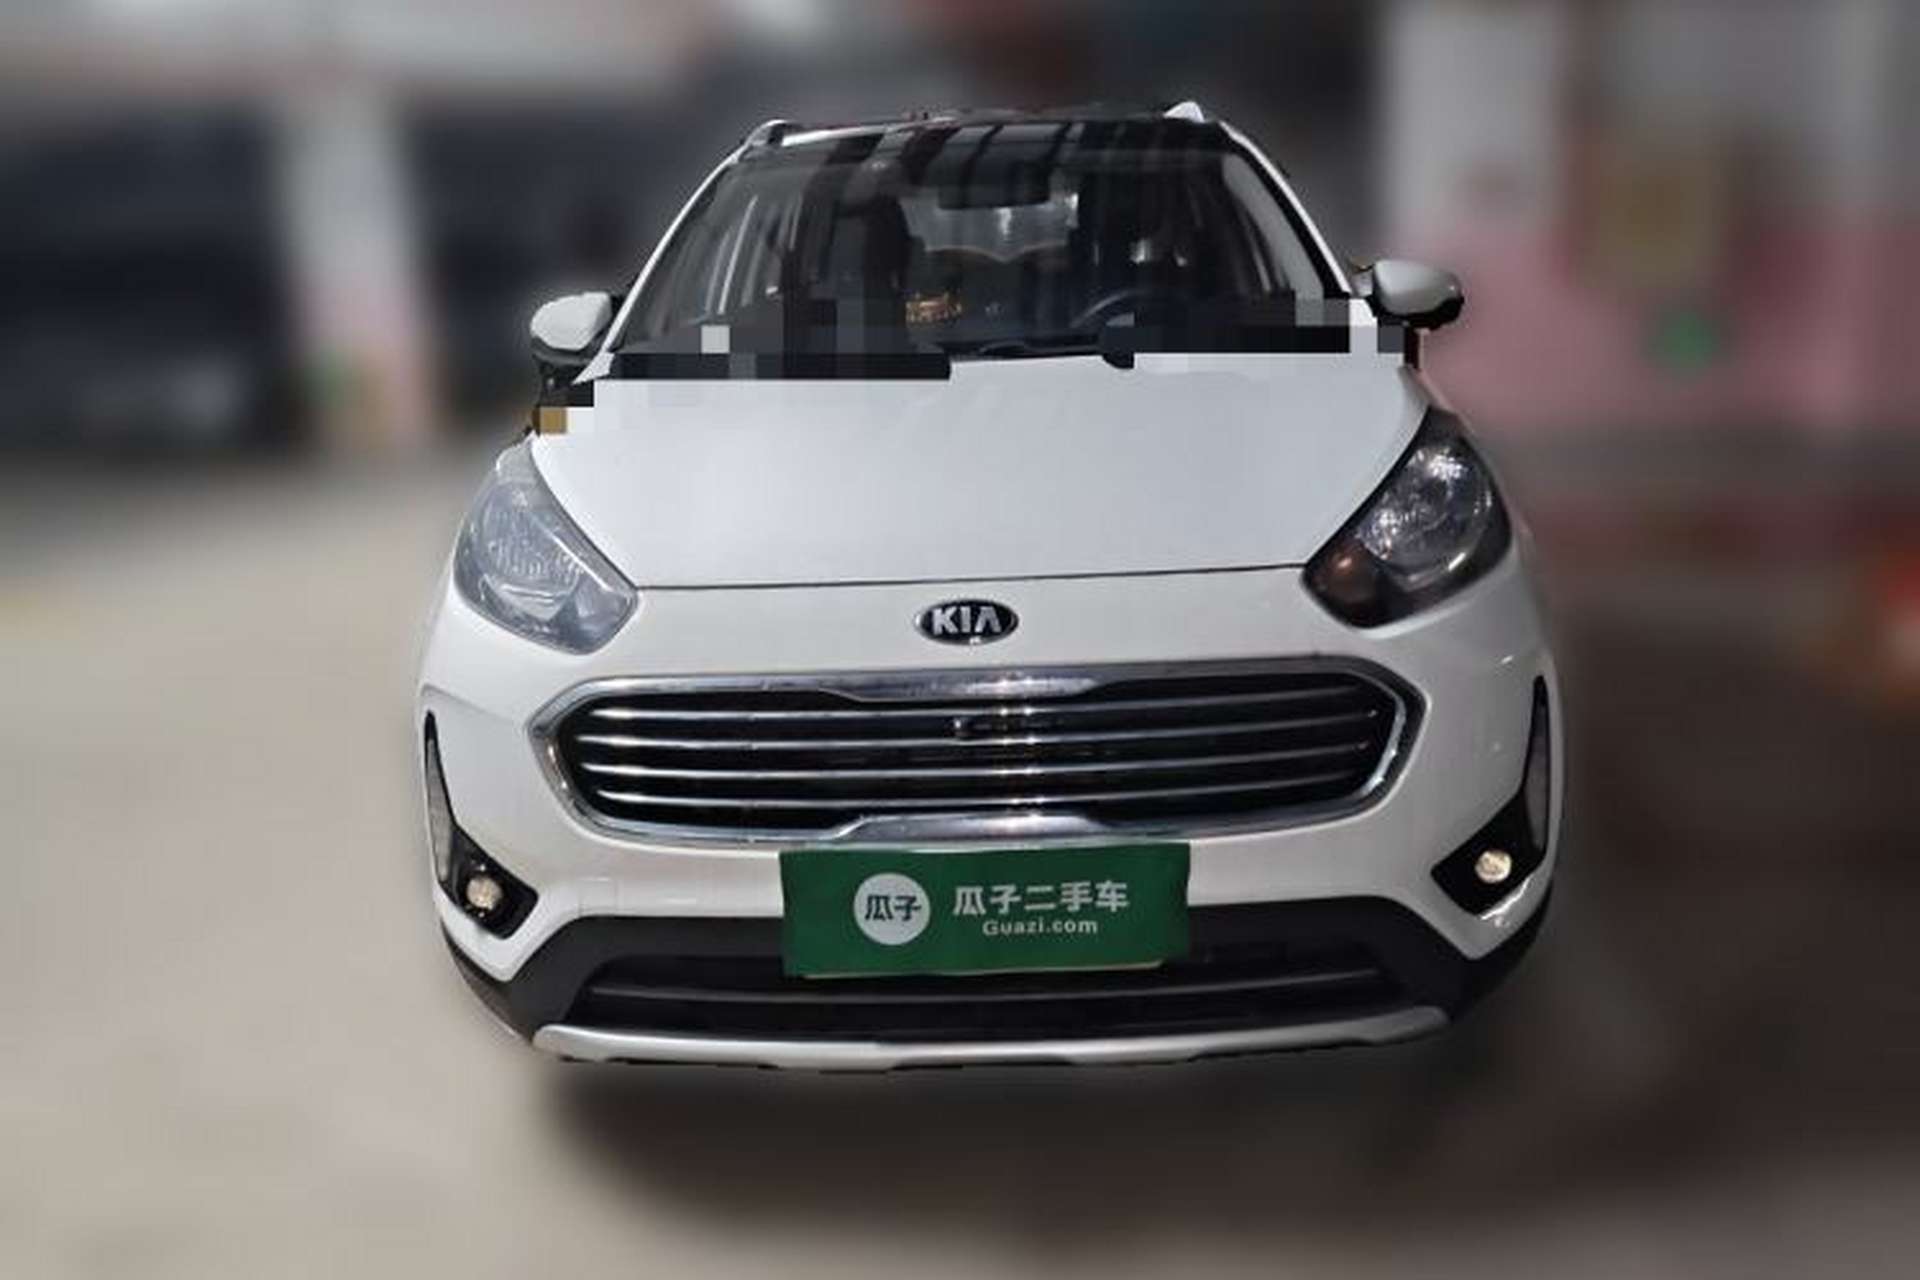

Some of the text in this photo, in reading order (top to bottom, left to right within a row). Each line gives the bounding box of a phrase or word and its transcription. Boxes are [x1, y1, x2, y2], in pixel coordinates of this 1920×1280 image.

[932, 606, 1001, 634] KIA
[865, 894, 922, 922] 瓜子
[953, 879, 1129, 916] 瓜子二手车
[983, 917, 1098, 936] Guazi.com
